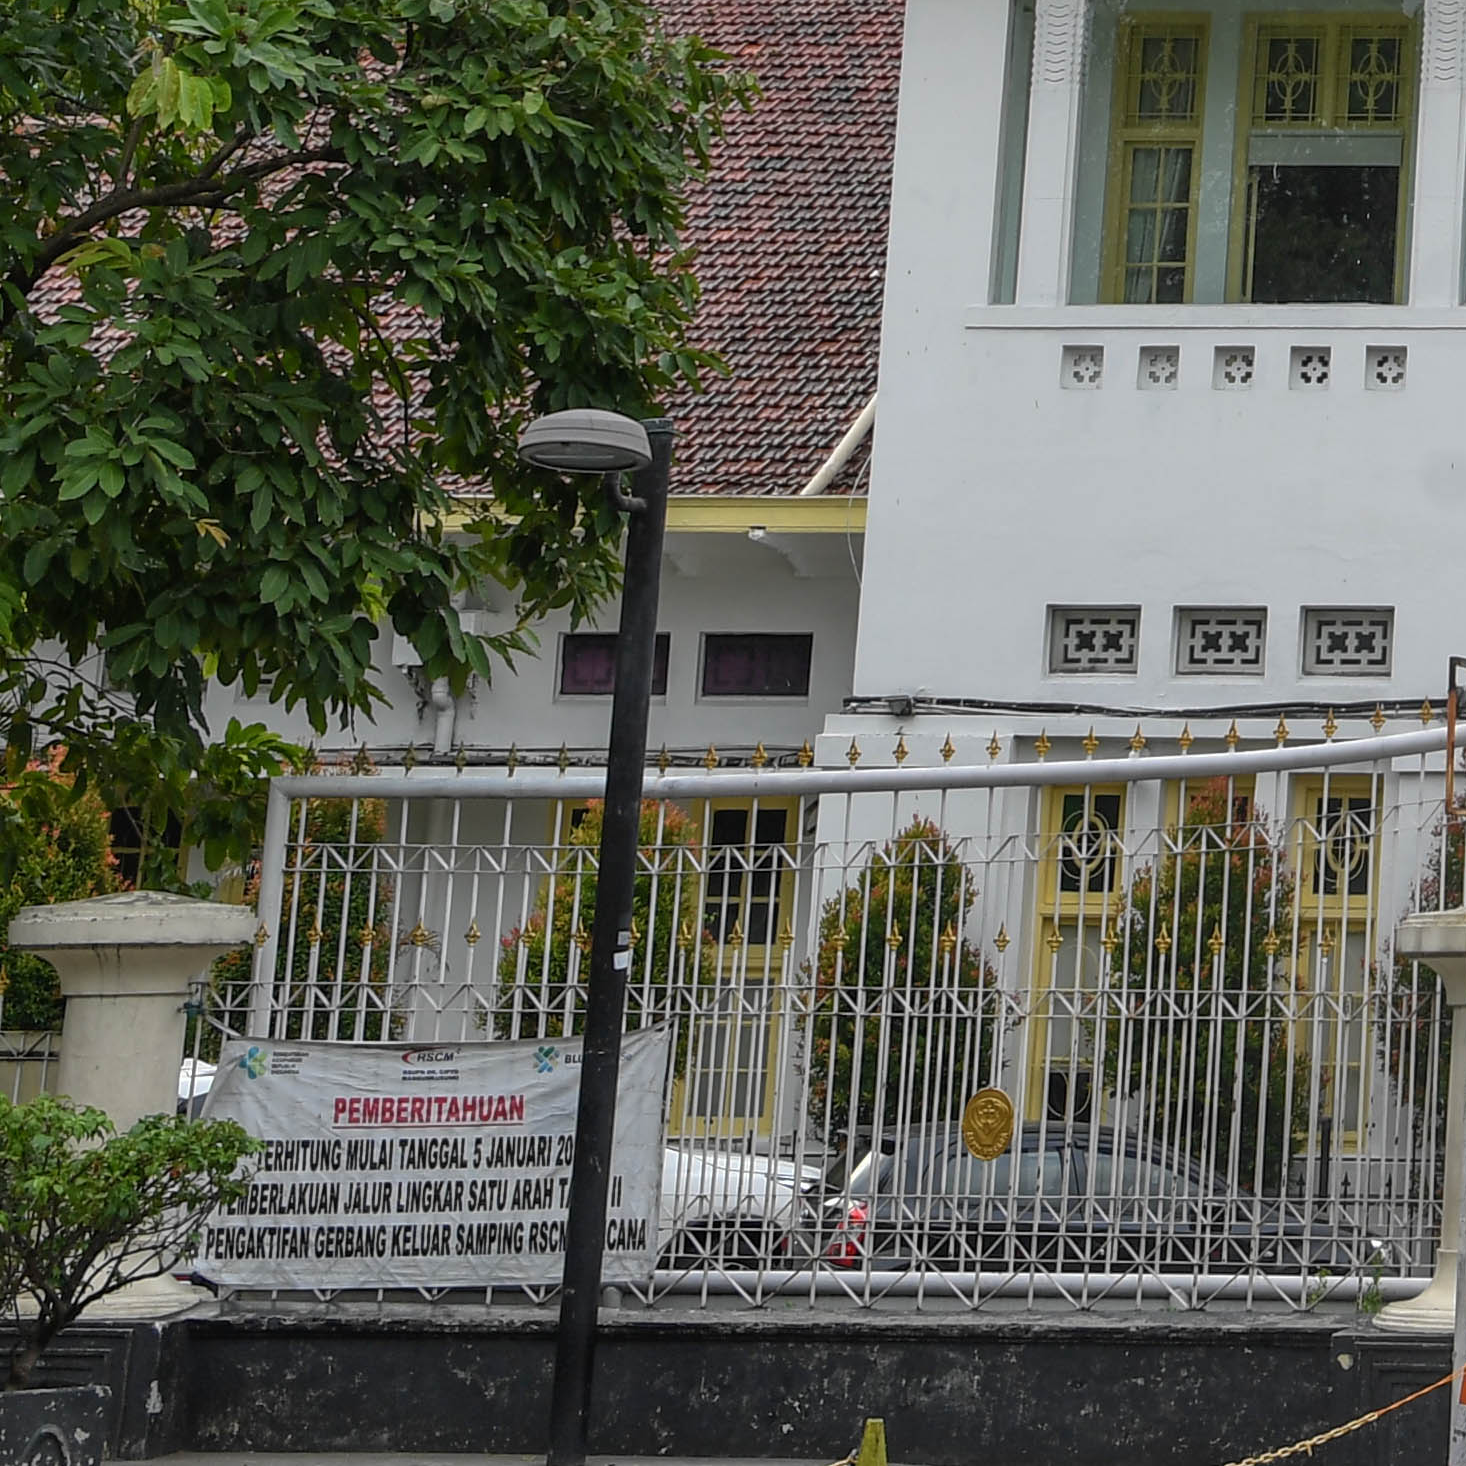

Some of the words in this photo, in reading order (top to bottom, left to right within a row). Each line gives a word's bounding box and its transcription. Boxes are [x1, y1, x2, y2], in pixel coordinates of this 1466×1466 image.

[416, 1052, 454, 1062] RSCM
[334, 1095, 524, 1124] PEMBERITAHUAN
[346, 1138, 394, 1171] MULAI
[398, 1138, 467, 1170] TANGGAL
[473, 1137, 483, 1169] 5
[486, 1136, 552, 1168] JANUARI
[344, 1182, 392, 1214] JALUR
[396, 1180, 464, 1213] LINGKAR
[468, 1179, 508, 1211] SATU
[511, 1178, 553, 1210] ARAH
[205, 1226, 310, 1260] PENGAKTIFAN
[314, 1224, 386, 1258] GERBANG
[390, 1224, 450, 1257] KELUAR
[455, 1221, 524, 1256] SAMPING
